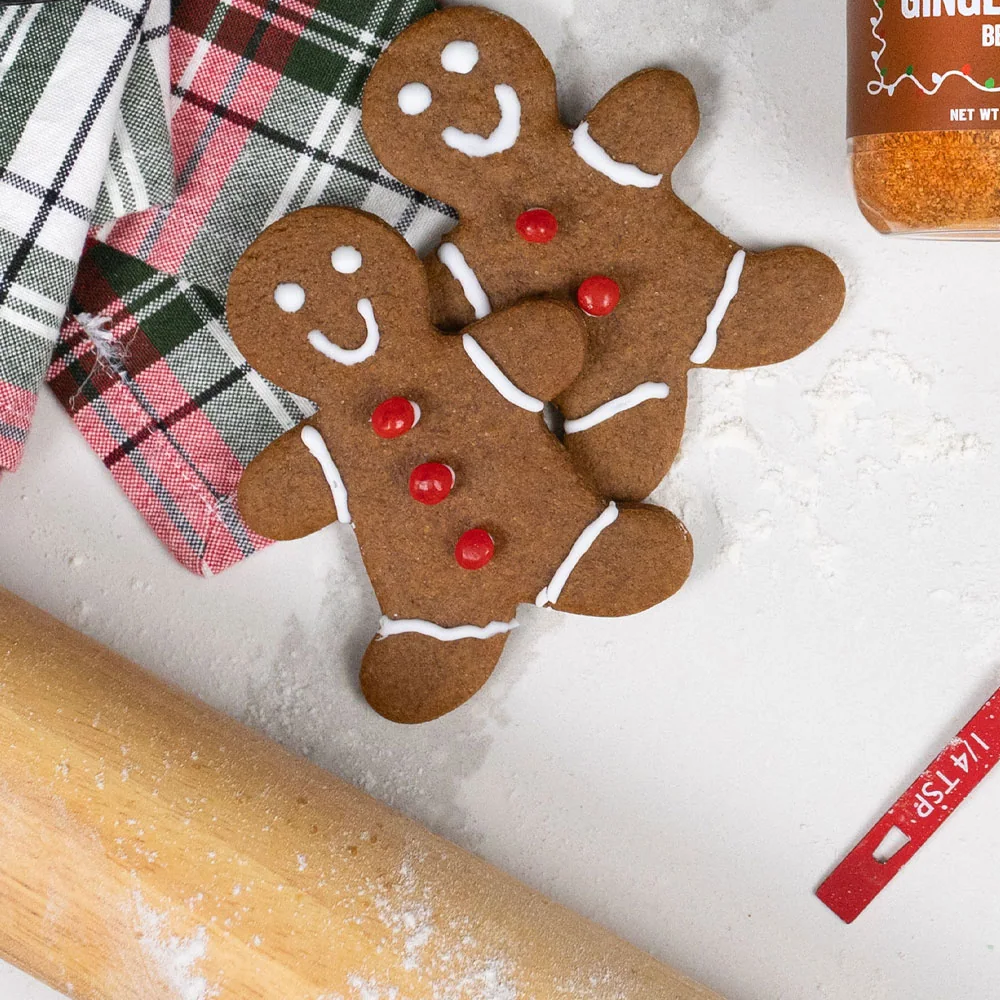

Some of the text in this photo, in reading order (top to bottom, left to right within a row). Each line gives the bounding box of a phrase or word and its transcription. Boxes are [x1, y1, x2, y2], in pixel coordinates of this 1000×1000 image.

[950, 108, 975, 122] NET
[980, 108, 999, 121] WT
[914, 731, 990, 818] 1/4 TSP
